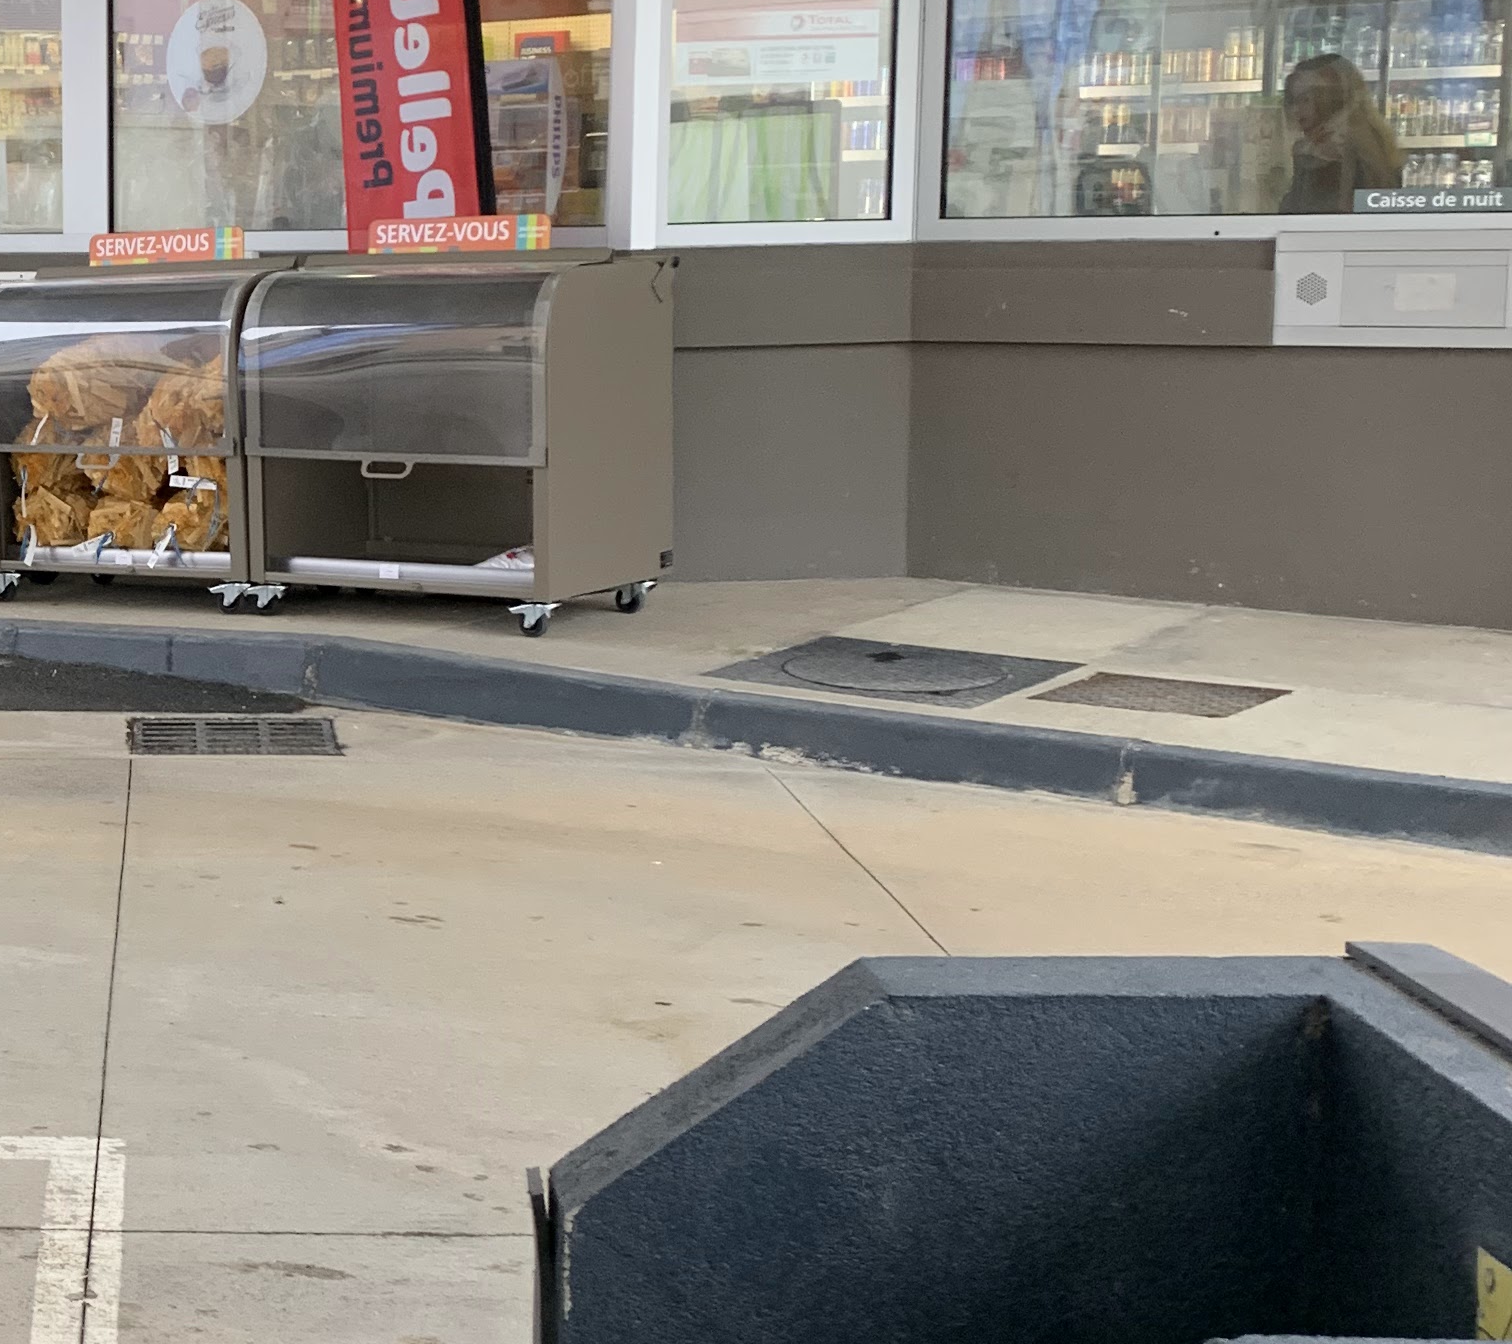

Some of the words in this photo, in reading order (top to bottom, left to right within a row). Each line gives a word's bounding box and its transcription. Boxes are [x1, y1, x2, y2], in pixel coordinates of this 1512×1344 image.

[1366, 192, 1427, 208] Caisse
[1432, 191, 1457, 207] de
[1463, 191, 1503, 207] nuit
[375, 219, 510, 245] SERVEZ-VOUS
[95, 233, 209, 257] SERVEZ-VOUS
